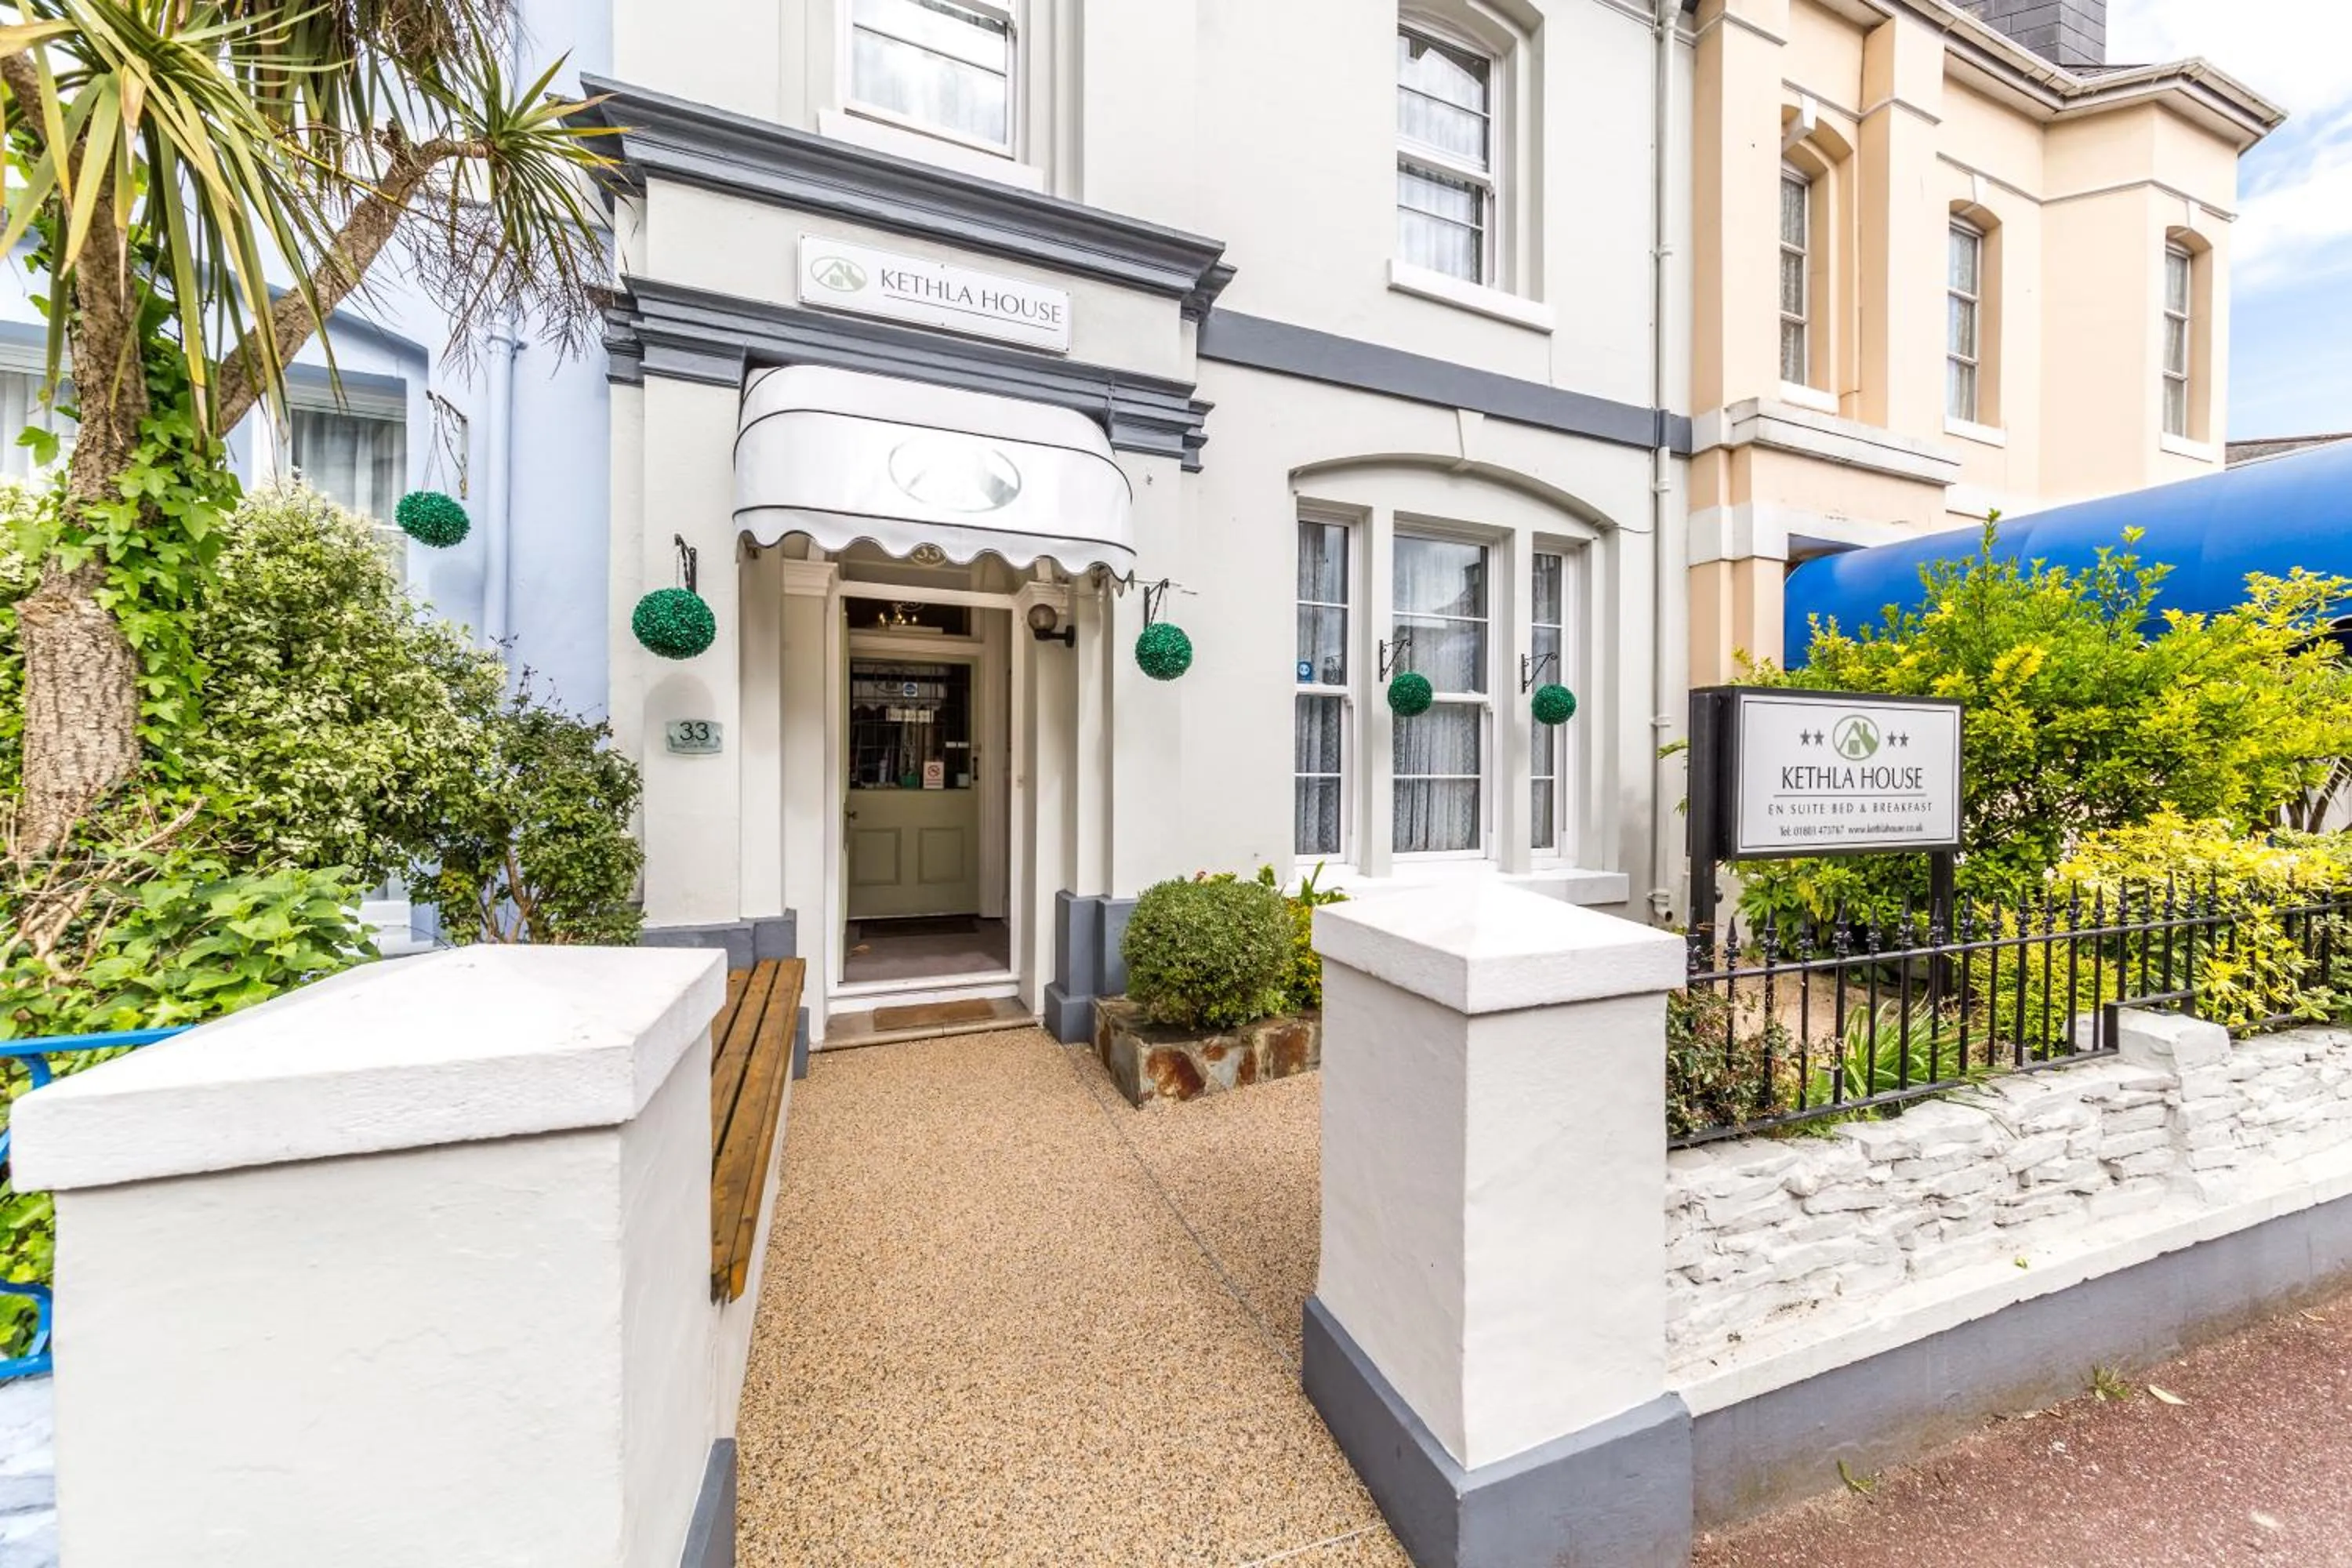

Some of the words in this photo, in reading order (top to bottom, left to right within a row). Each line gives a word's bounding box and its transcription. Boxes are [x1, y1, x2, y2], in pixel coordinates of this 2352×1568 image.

[881, 268, 973, 305] KETHLA
[982, 289, 1062, 324] HOUSE
[680, 722, 710, 741] 33
[1781, 766, 1855, 789] KETHLA
[1860, 766, 1924, 789] HOUSE
[1768, 804, 1784, 815] EN
[1790, 803, 1824, 815] SUITE
[1831, 802, 1854, 815] BED
[1859, 803, 1867, 813] &
[1873, 801, 1933, 813] BREAKFAST
